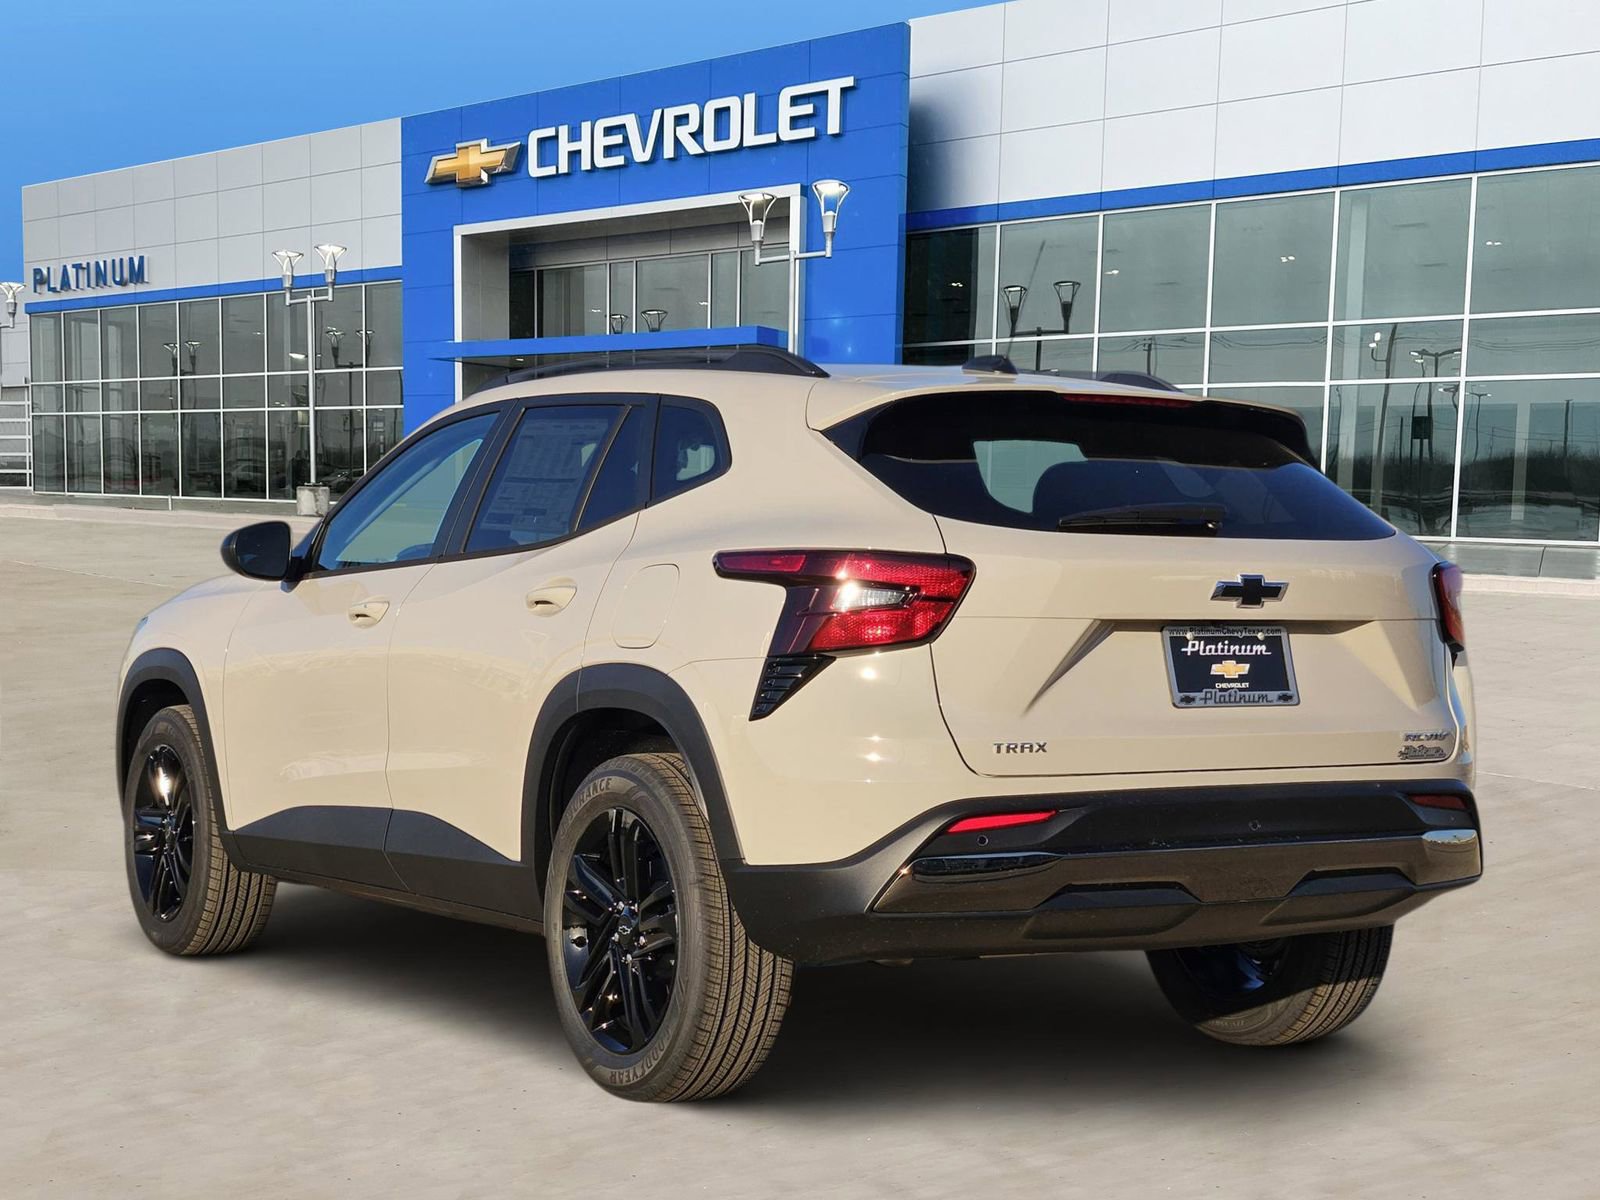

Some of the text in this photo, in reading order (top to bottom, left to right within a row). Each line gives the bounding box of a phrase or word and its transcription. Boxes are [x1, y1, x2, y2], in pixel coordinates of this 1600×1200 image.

[528, 76, 855, 178] CHEVROLET
[33, 255, 146, 293] PLATINUM
[1168, 627, 1282, 638] wwwPlatinumChevyTexa.com
[1181, 640, 1272, 656] Platinum
[1199, 690, 1274, 705] Platinum
[993, 742, 1047, 754] TRAX
